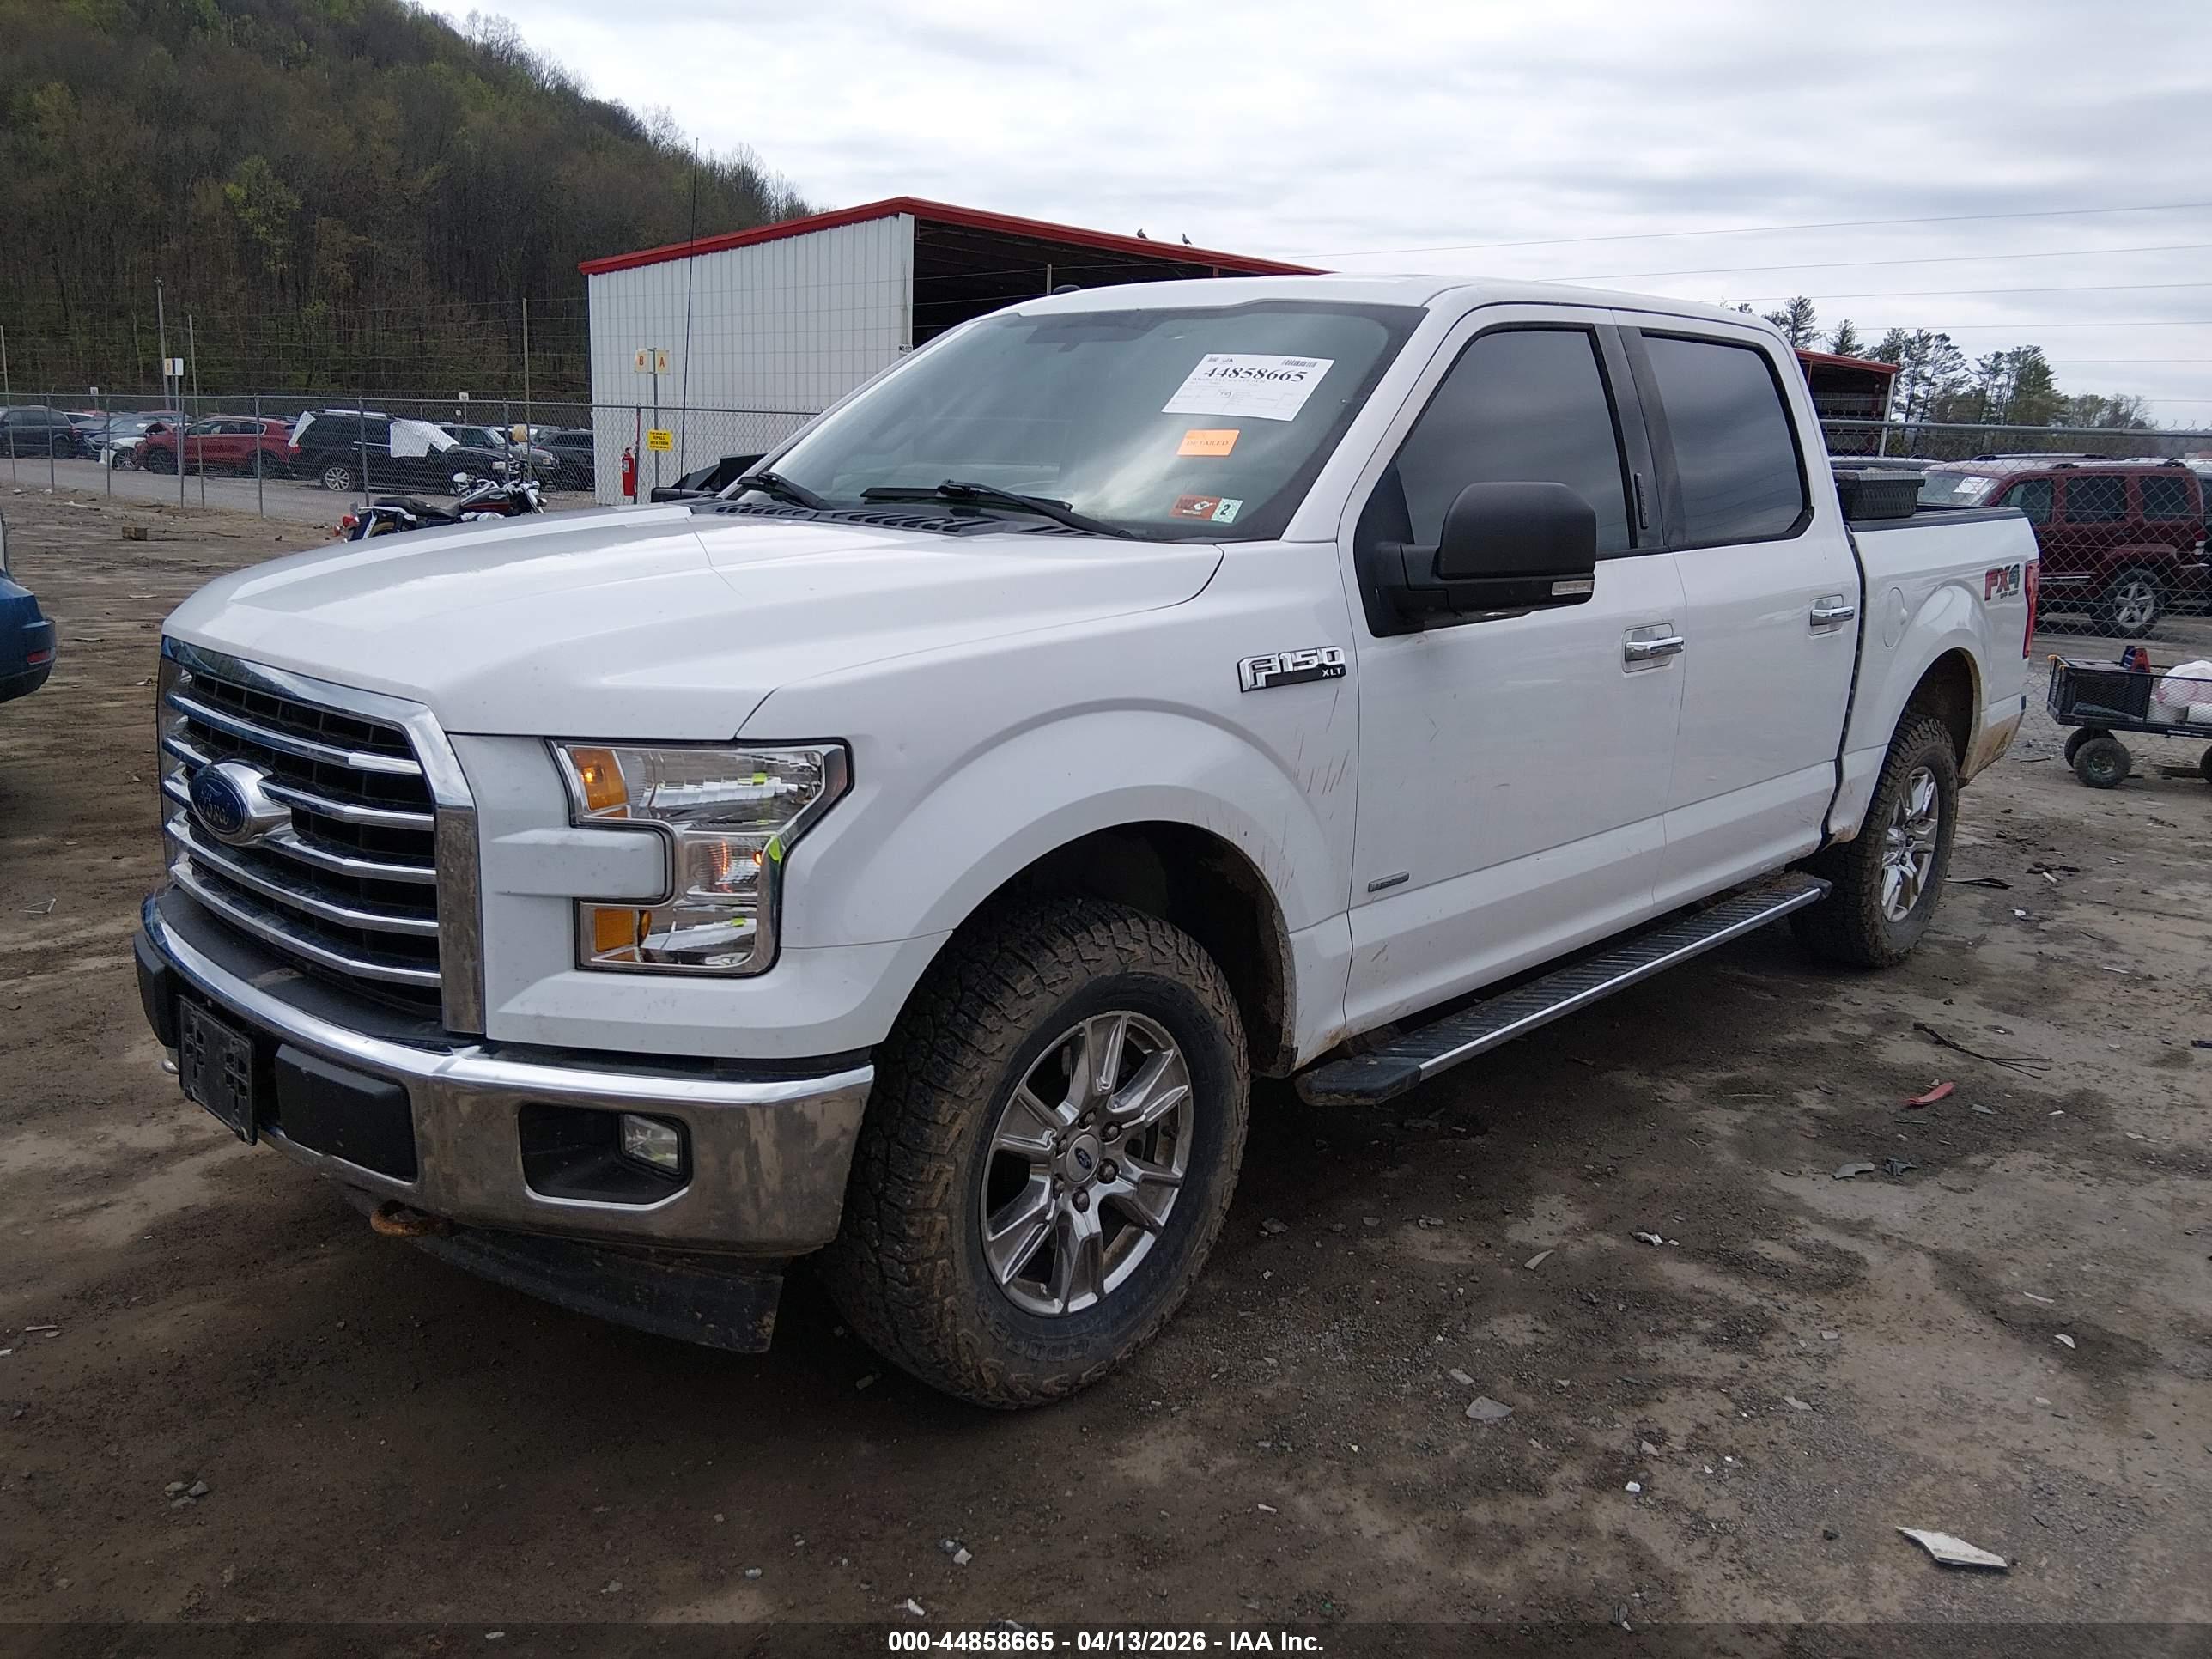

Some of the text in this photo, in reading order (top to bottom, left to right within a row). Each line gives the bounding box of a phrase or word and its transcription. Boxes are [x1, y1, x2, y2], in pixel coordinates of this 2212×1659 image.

[639, 356, 644, 366] B
[659, 356, 665, 368] A
[1204, 366, 1308, 383] 44858665
[1219, 504, 1231, 516] 2
[1984, 563, 2020, 601] FX4
[1322, 666, 1342, 677] XLT
